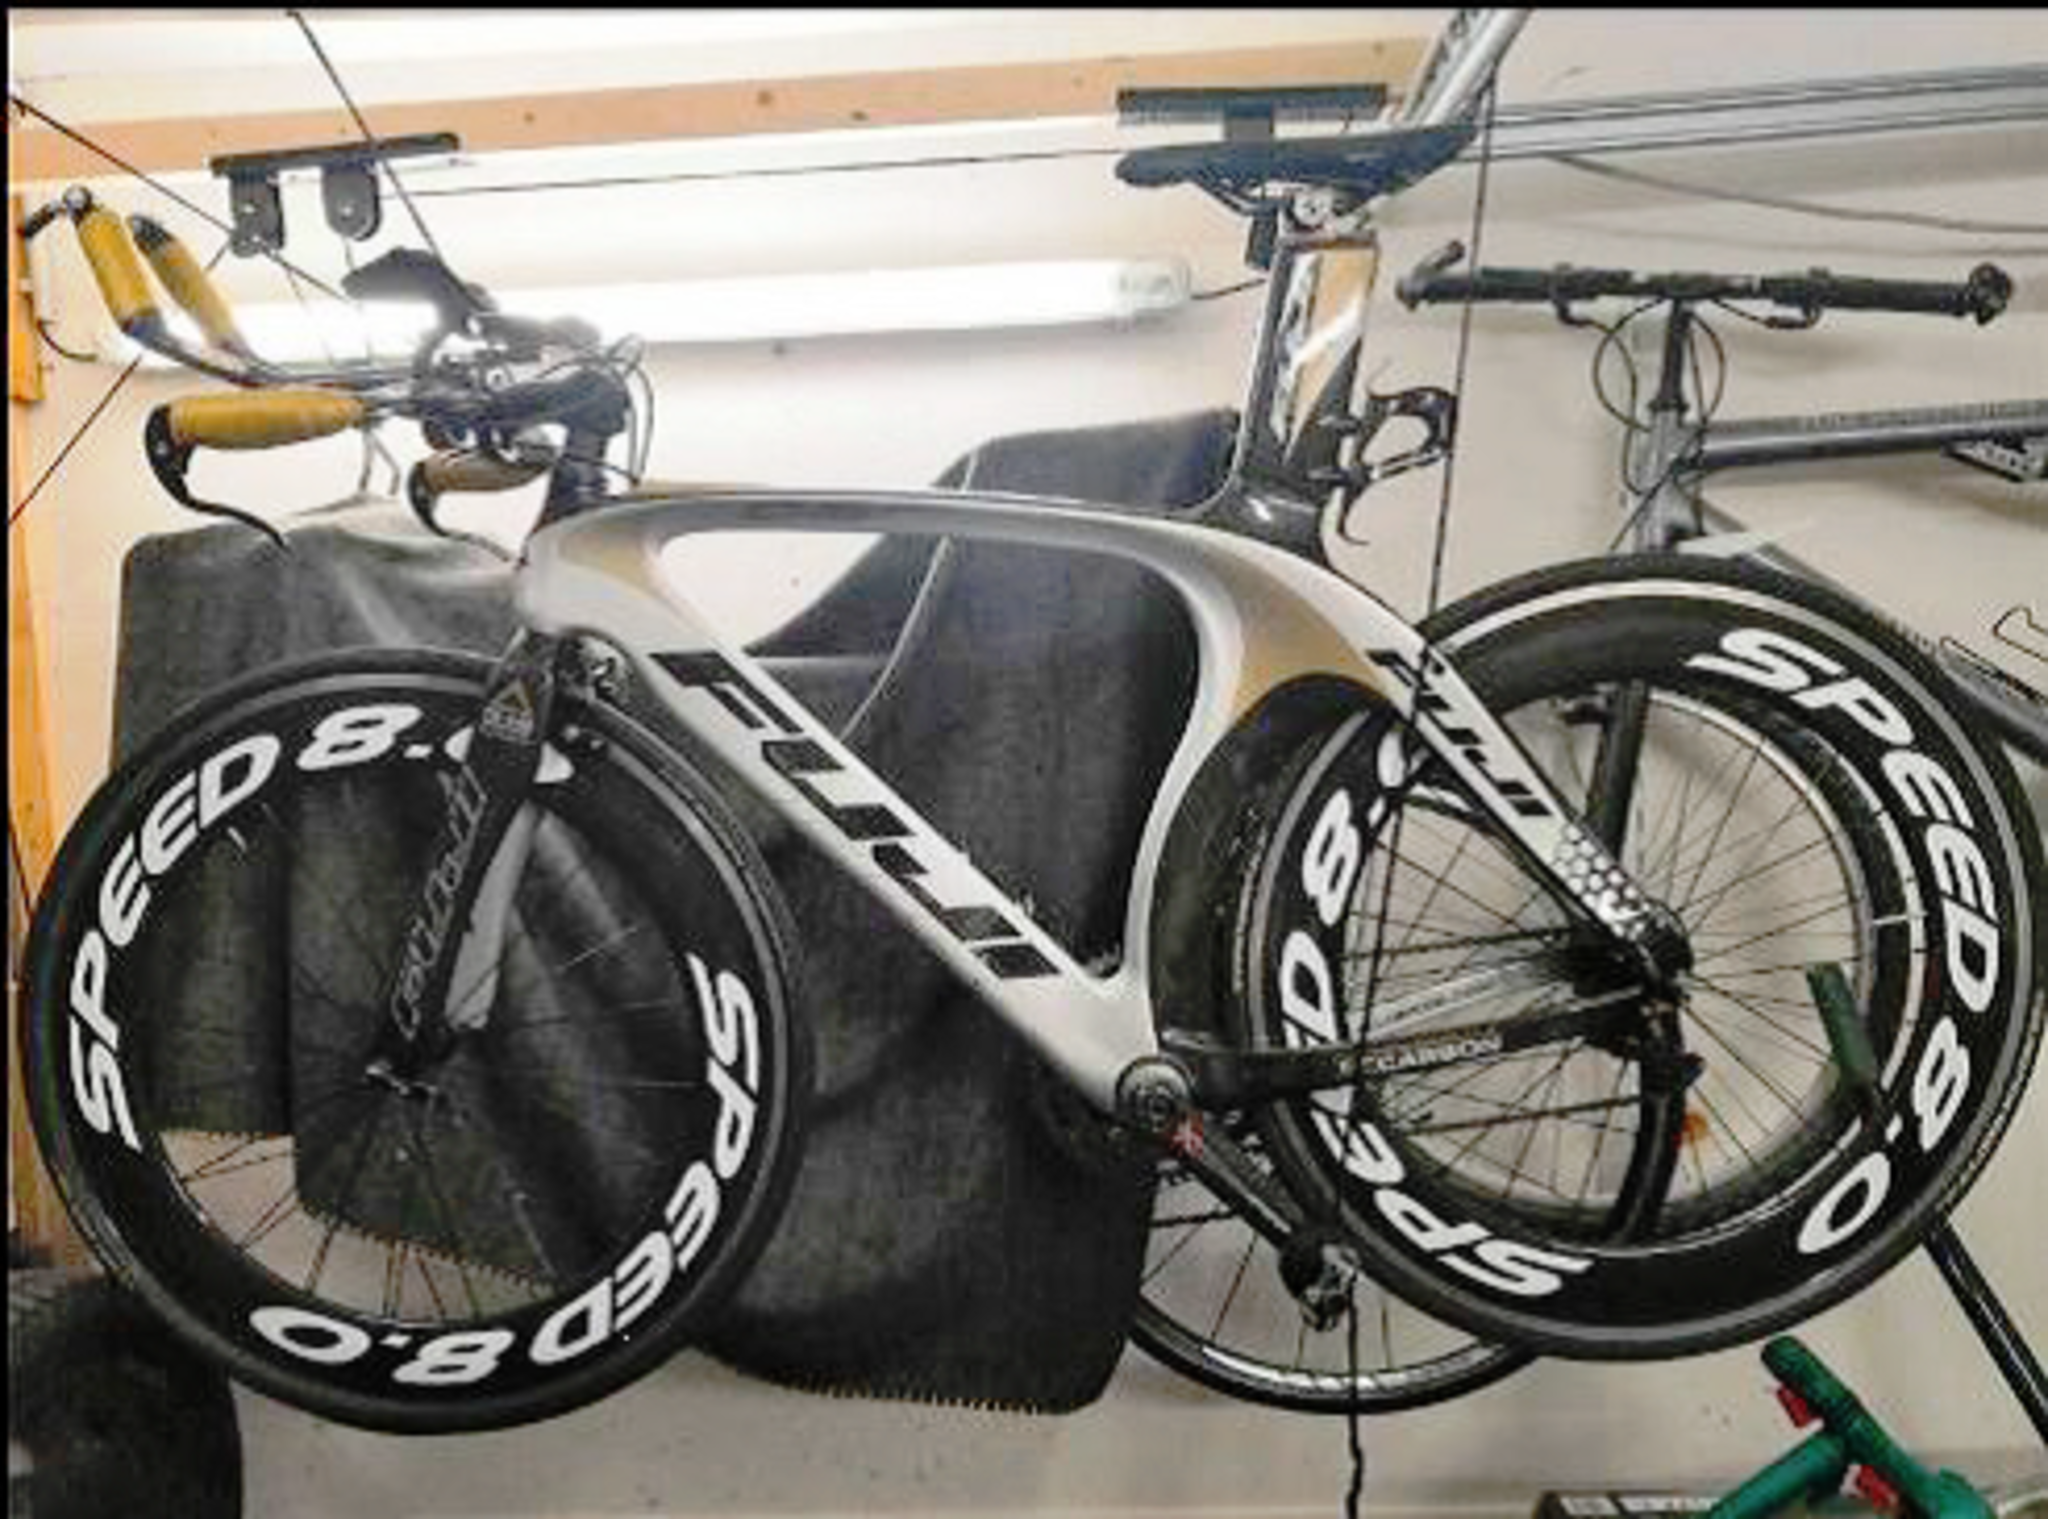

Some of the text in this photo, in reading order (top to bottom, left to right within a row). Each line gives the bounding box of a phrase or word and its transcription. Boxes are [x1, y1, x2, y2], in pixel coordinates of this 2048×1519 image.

[69, 736, 282, 1152] SPEED
[648, 651, 1062, 979] FUJI
[1302, 731, 1406, 928] 8.
[1686, 628, 2000, 1254] SPEED 8.0
[250, 952, 759, 1385] SPEED 8.0
